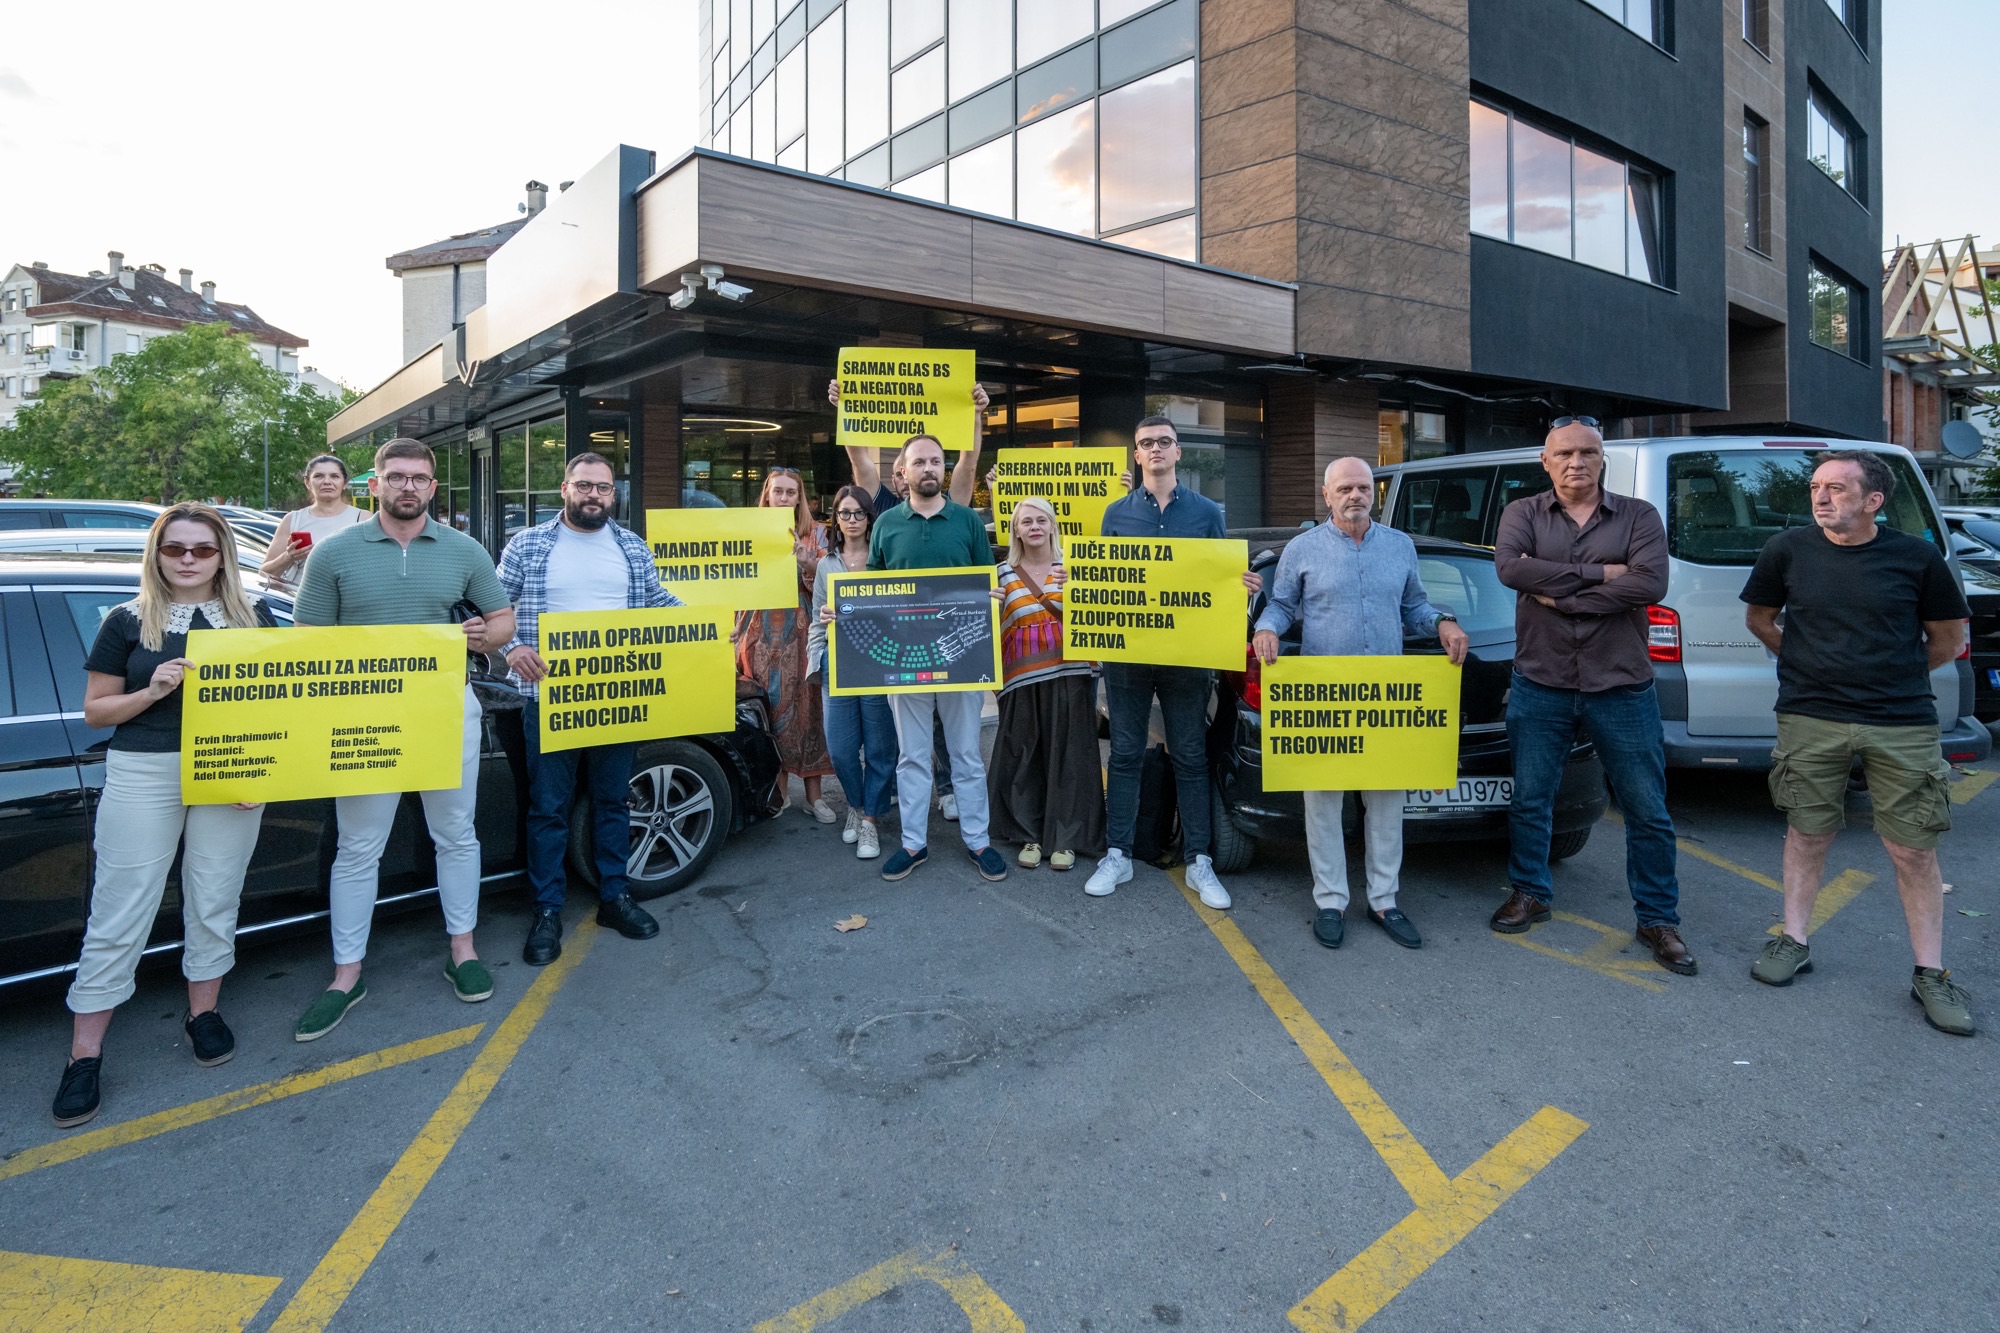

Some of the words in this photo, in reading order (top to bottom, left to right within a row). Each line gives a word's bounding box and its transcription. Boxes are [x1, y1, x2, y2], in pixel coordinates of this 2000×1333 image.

[843, 360, 895, 377] SRAMAN
[898, 362, 930, 377] GLAS
[933, 363, 950, 378] BS
[842, 380, 858, 395] ZA
[860, 381, 924, 397] NEGATORA
[844, 400, 907, 415] GENOCIDA
[909, 401, 938, 416] JOLA
[843, 416, 925, 435] VUČUROVIĆA
[998, 462, 1072, 477] SREBRENICA
[1074, 462, 1117, 477] PAMTI.
[998, 481, 1053, 496] PAMTIMO
[1056, 482, 1061, 496] I
[1063, 482, 1080, 497] MI
[1082, 480, 1107, 497] VAŠ
[1062, 502, 1071, 517] U
[654, 541, 719, 559] MANDAT
[722, 540, 753, 556] NIJE
[1070, 541, 1106, 560] JUČE
[1109, 544, 1151, 561] RUKA
[1155, 545, 1173, 561] ZA
[704, 562, 758, 580] ISTINE!
[1070, 566, 1146, 584] NEGATORE
[839, 586, 857, 598] ONI
[859, 585, 873, 597] SU
[875, 583, 916, 596] GLASALI
[1070, 588, 1147, 606] GENOCIDA
[1160, 591, 1212, 608] DANAS
[1070, 610, 1175, 629] ZLOUPOTREBA
[548, 629, 601, 651] NEMA
[605, 622, 718, 648] OPRAVDANJA
[1070, 629, 1126, 649] ŽRTAVA
[199, 664, 231, 680] ONI
[235, 662, 259, 679] SU
[263, 659, 331, 677] GLASALI
[335, 659, 355, 674] ZA
[358, 656, 438, 673] NEGATORA
[548, 658, 571, 678] ZA
[575, 650, 662, 676] PODRŠKU
[198, 683, 288, 703] GENOCIDA
[292, 683, 304, 698] U
[307, 678, 403, 698] SREBRENICI
[549, 677, 666, 705] NEGATORIMA
[1269, 683, 1382, 702] SREBRENICA
[1386, 683, 1423, 702] NIJE
[549, 704, 648, 732] GENOCIDA!
[1270, 709, 1352, 728] PREDMET
[1356, 706, 1448, 728] POLITIČKE
[194, 735, 220, 745] Ervin
[222, 731, 282, 743] Ibrahimovic
[284, 730, 288, 740] i
[331, 726, 364, 736] Jasmin
[331, 738, 351, 748] Edin
[353, 736, 380, 746] Dešić,
[1270, 735, 1364, 755] TRGOVINE!
[194, 746, 245, 758] poslanici:
[330, 750, 355, 759] Amer
[194, 758, 229, 769] Mirsad
[231, 756, 277, 767] Nurkovic,
[330, 761, 365, 771] Kenana
[367, 758, 397, 769] Strujić
[193, 771, 216, 781] Adel
